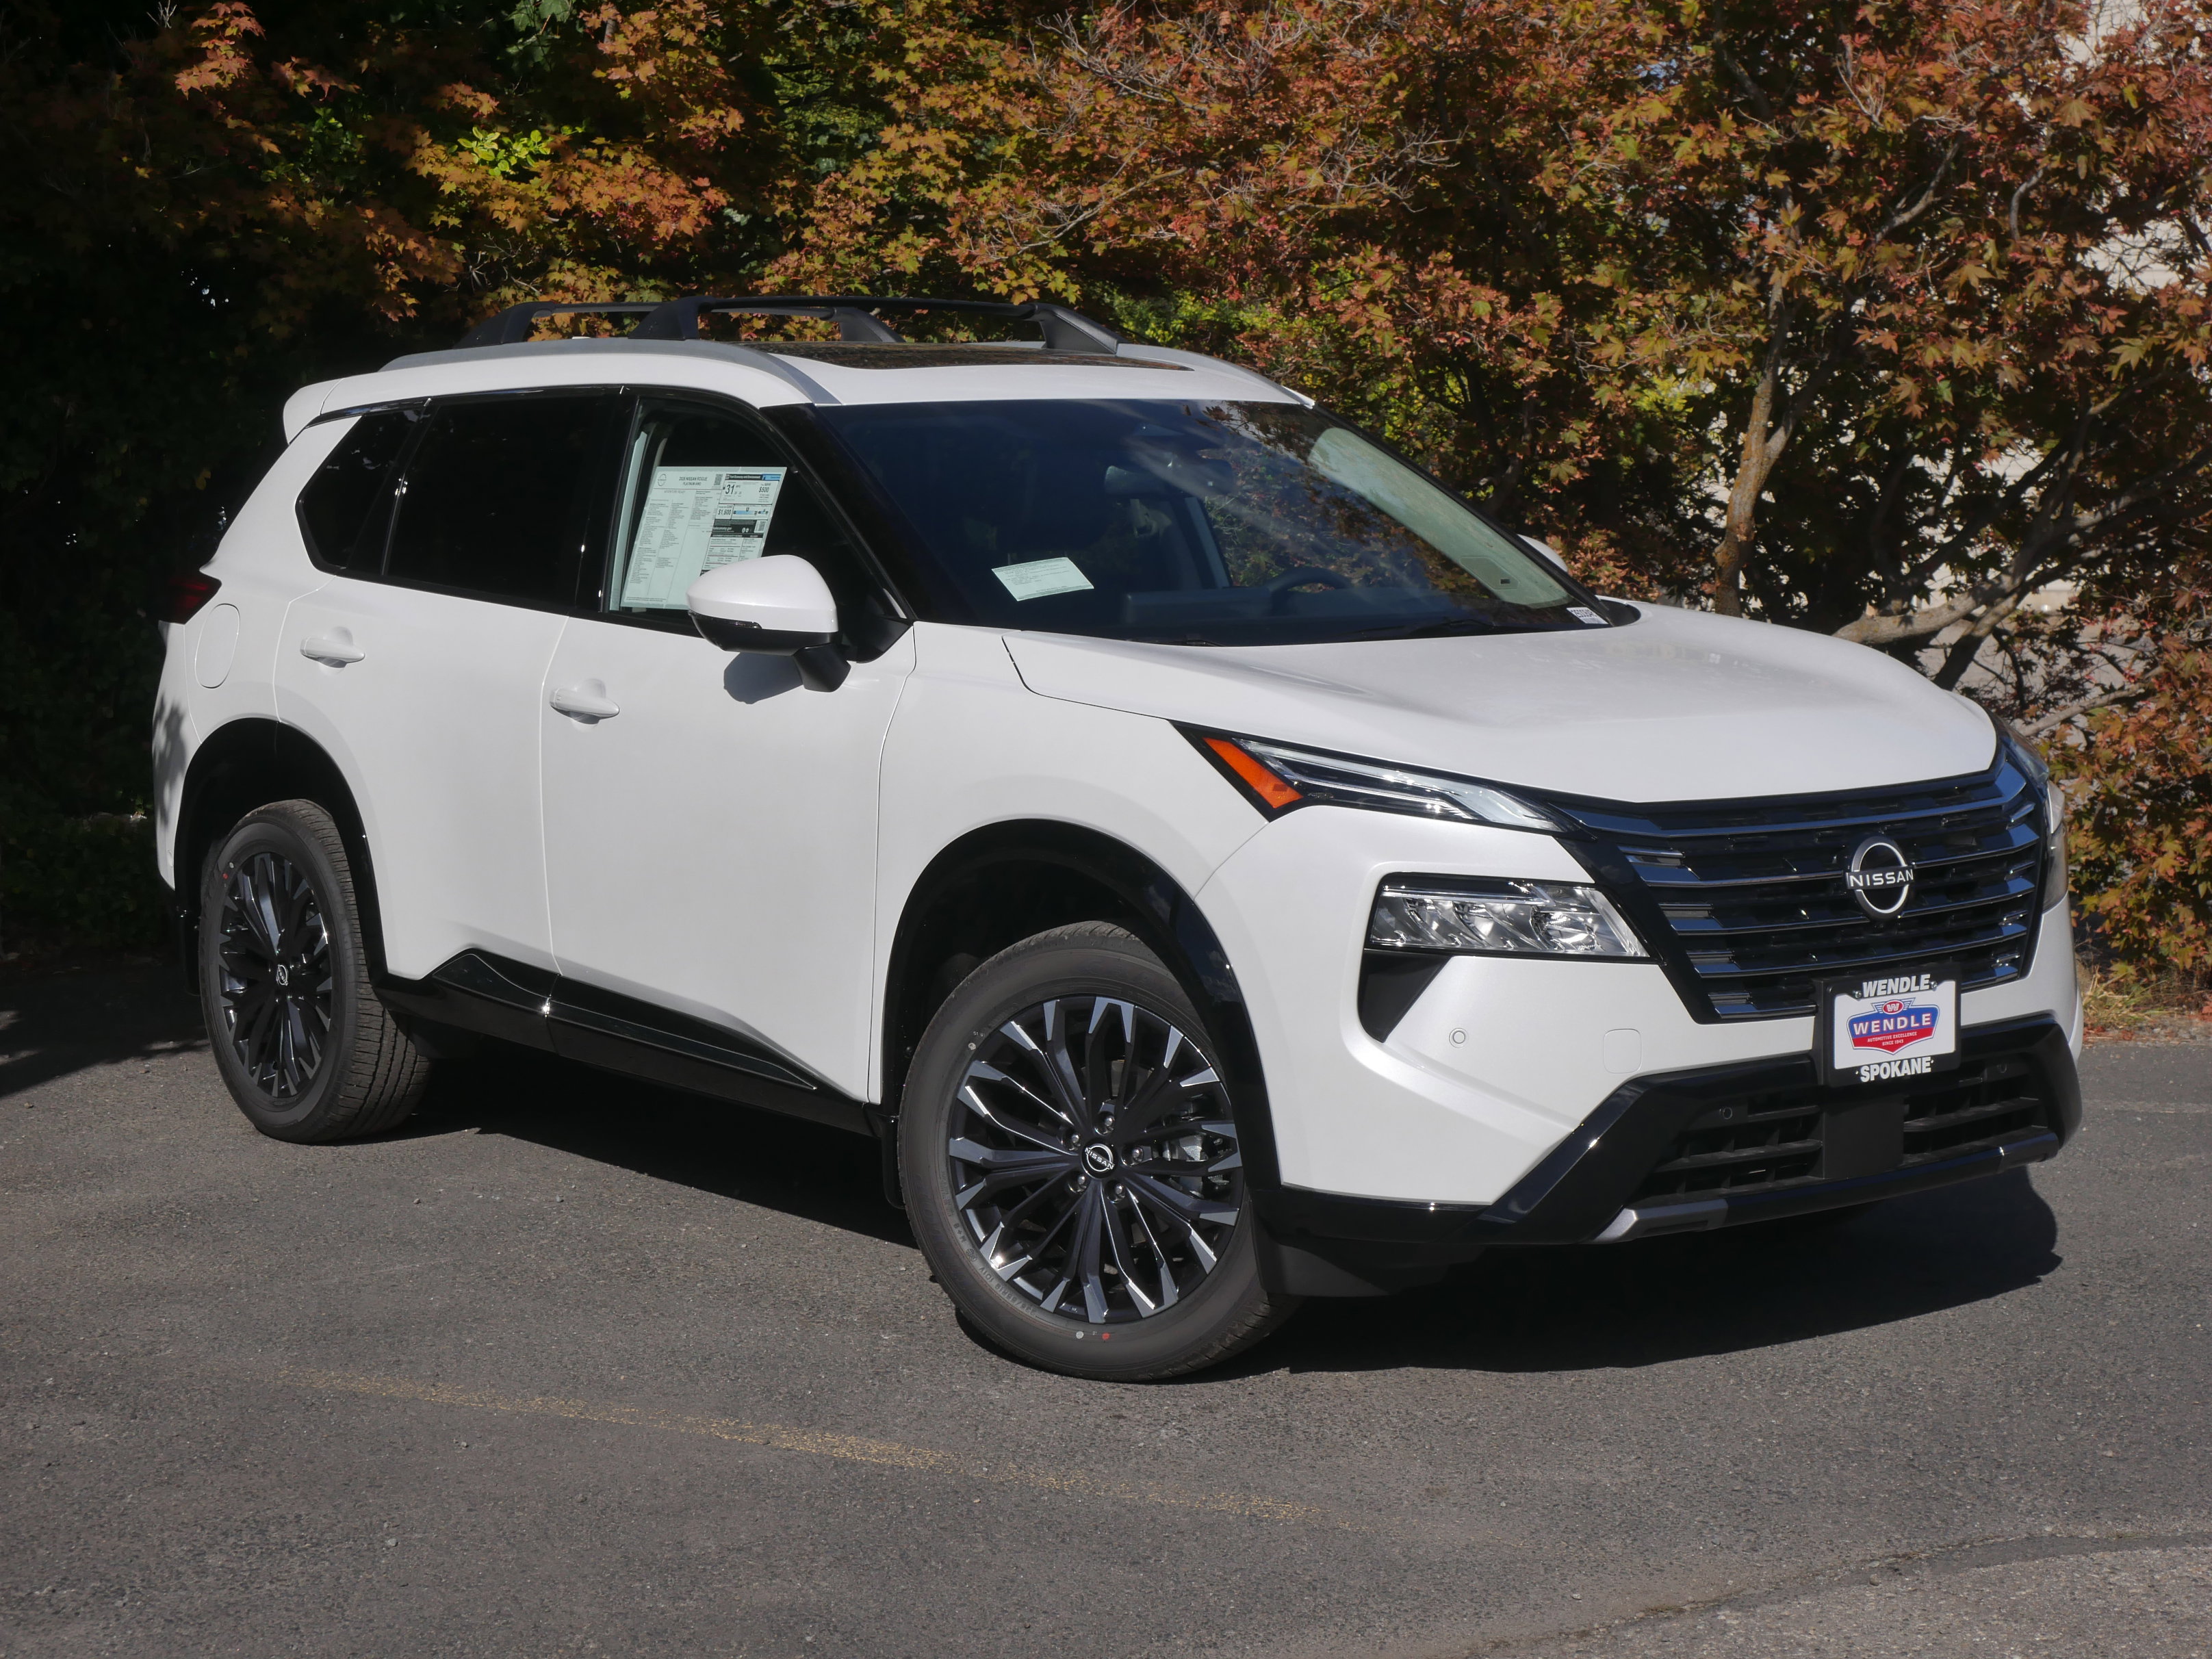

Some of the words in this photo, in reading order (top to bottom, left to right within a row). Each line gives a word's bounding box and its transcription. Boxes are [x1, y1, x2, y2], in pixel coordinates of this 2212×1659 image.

[725, 484, 735, 494] 31
[1849, 869, 1914, 888] NISSAN
[1862, 974, 1931, 998] WENDLE
[1886, 1003, 1900, 1012] W
[1853, 1013, 1931, 1036] WENDLE
[1867, 1035, 1892, 1043] AUTOMOTIVE
[1860, 1057, 1931, 1082] SPOKANE
[1085, 1147, 1114, 1170] NISSAN
